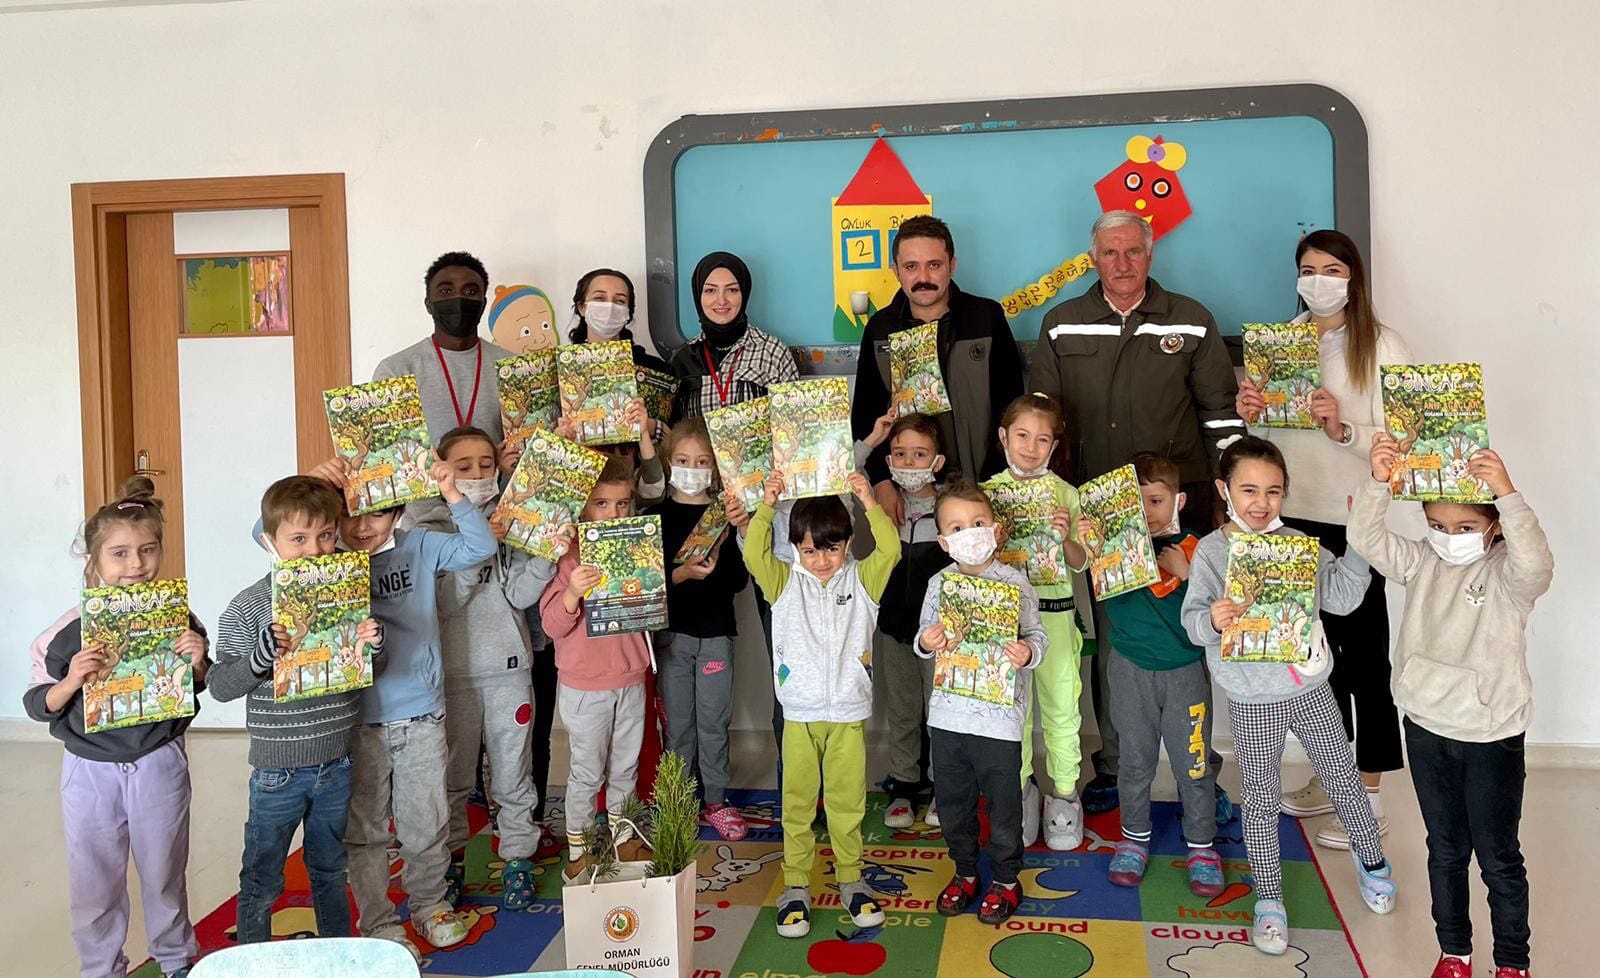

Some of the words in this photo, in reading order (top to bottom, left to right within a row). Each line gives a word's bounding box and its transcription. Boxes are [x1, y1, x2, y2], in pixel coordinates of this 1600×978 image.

[841, 217, 872, 230] ONLUK
[855, 240, 872, 257] 2
[1002, 298, 1019, 315] 30
[1151, 925, 1249, 942] cloud
[604, 948, 641, 959] ORMAN
